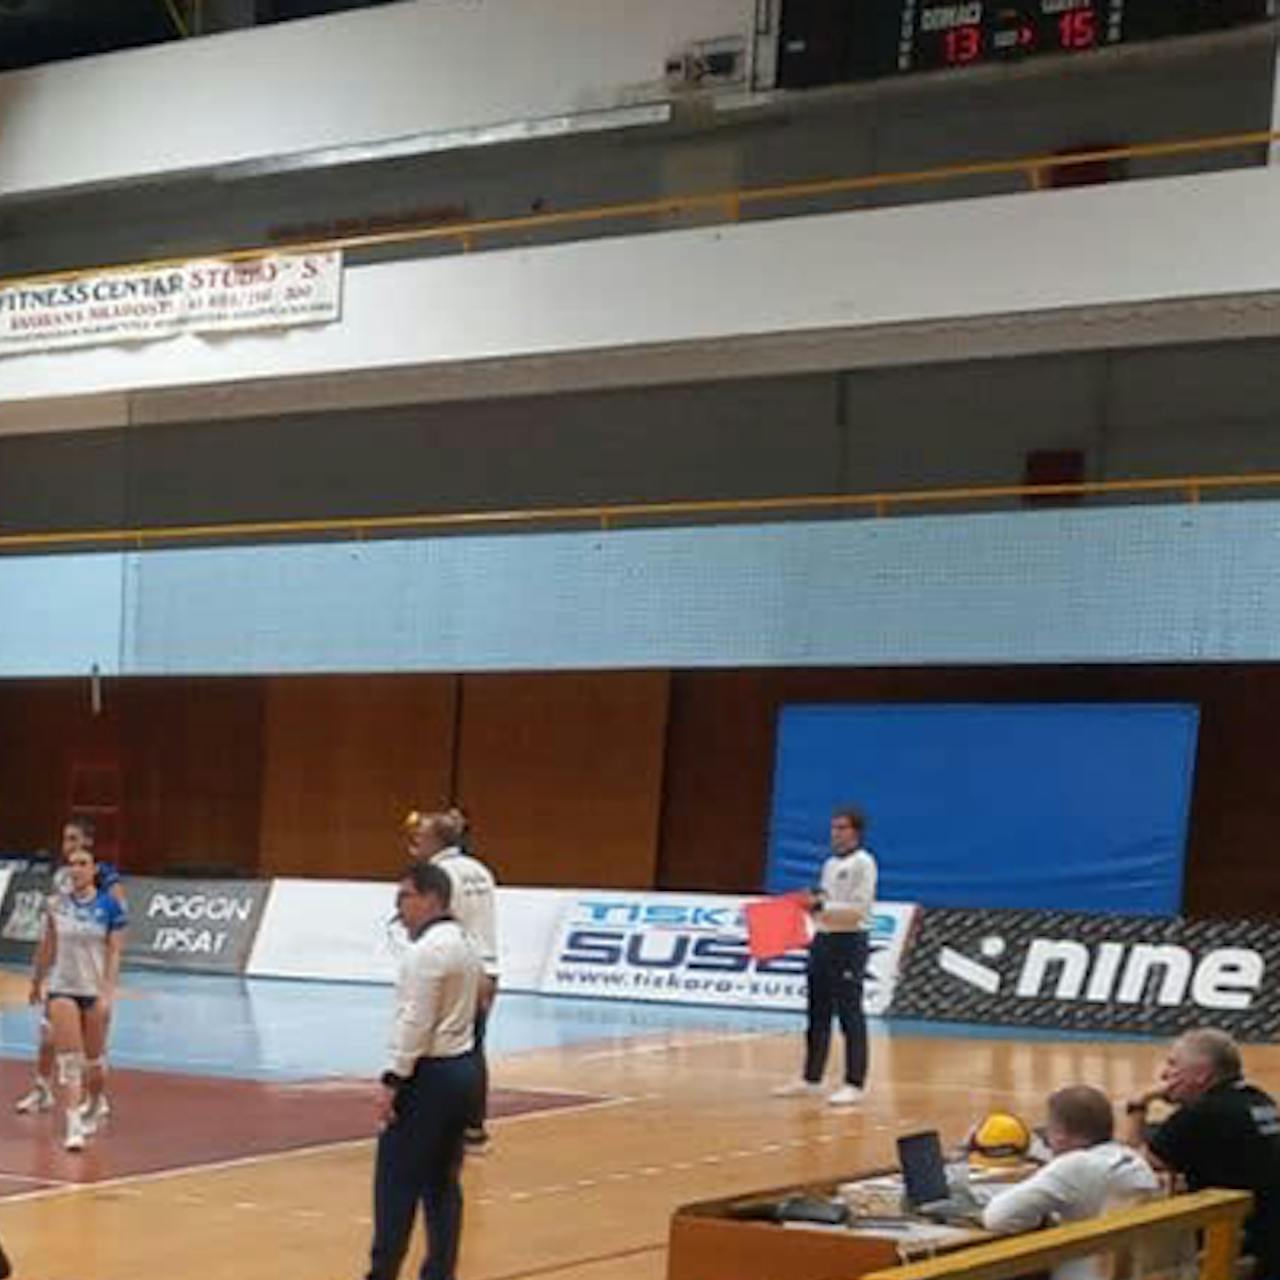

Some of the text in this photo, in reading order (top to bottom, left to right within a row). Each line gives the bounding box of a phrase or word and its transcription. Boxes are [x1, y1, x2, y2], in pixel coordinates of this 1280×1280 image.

[944, 26, 980, 62] 13
[1059, 10, 1095, 48] 15
[93, 272, 183, 302] CENTAR
[146, 894, 253, 920] POGON
[1016, 938, 1264, 1008] nine
